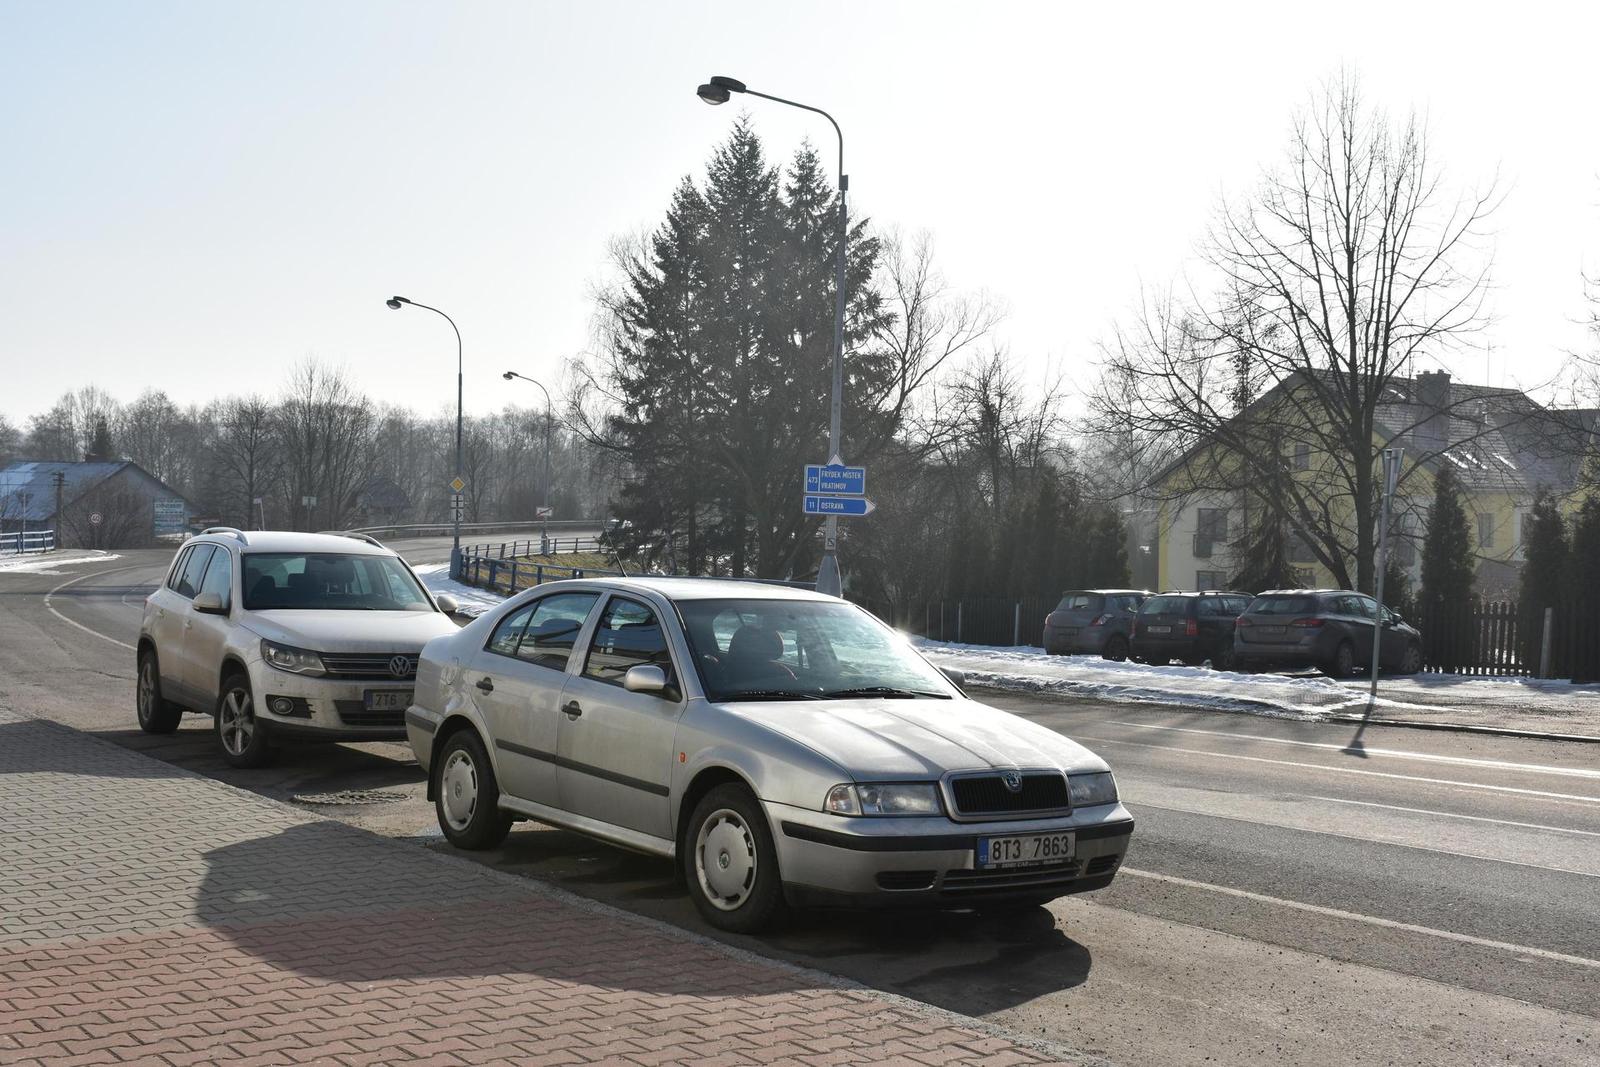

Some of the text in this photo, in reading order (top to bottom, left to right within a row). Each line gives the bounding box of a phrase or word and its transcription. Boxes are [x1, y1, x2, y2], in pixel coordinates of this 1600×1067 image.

[821, 482, 847, 490] VRATIMOV
[808, 501, 815, 509] 11
[820, 502, 845, 510] OSTRAVA
[992, 835, 1069, 860] 8T3 7863
